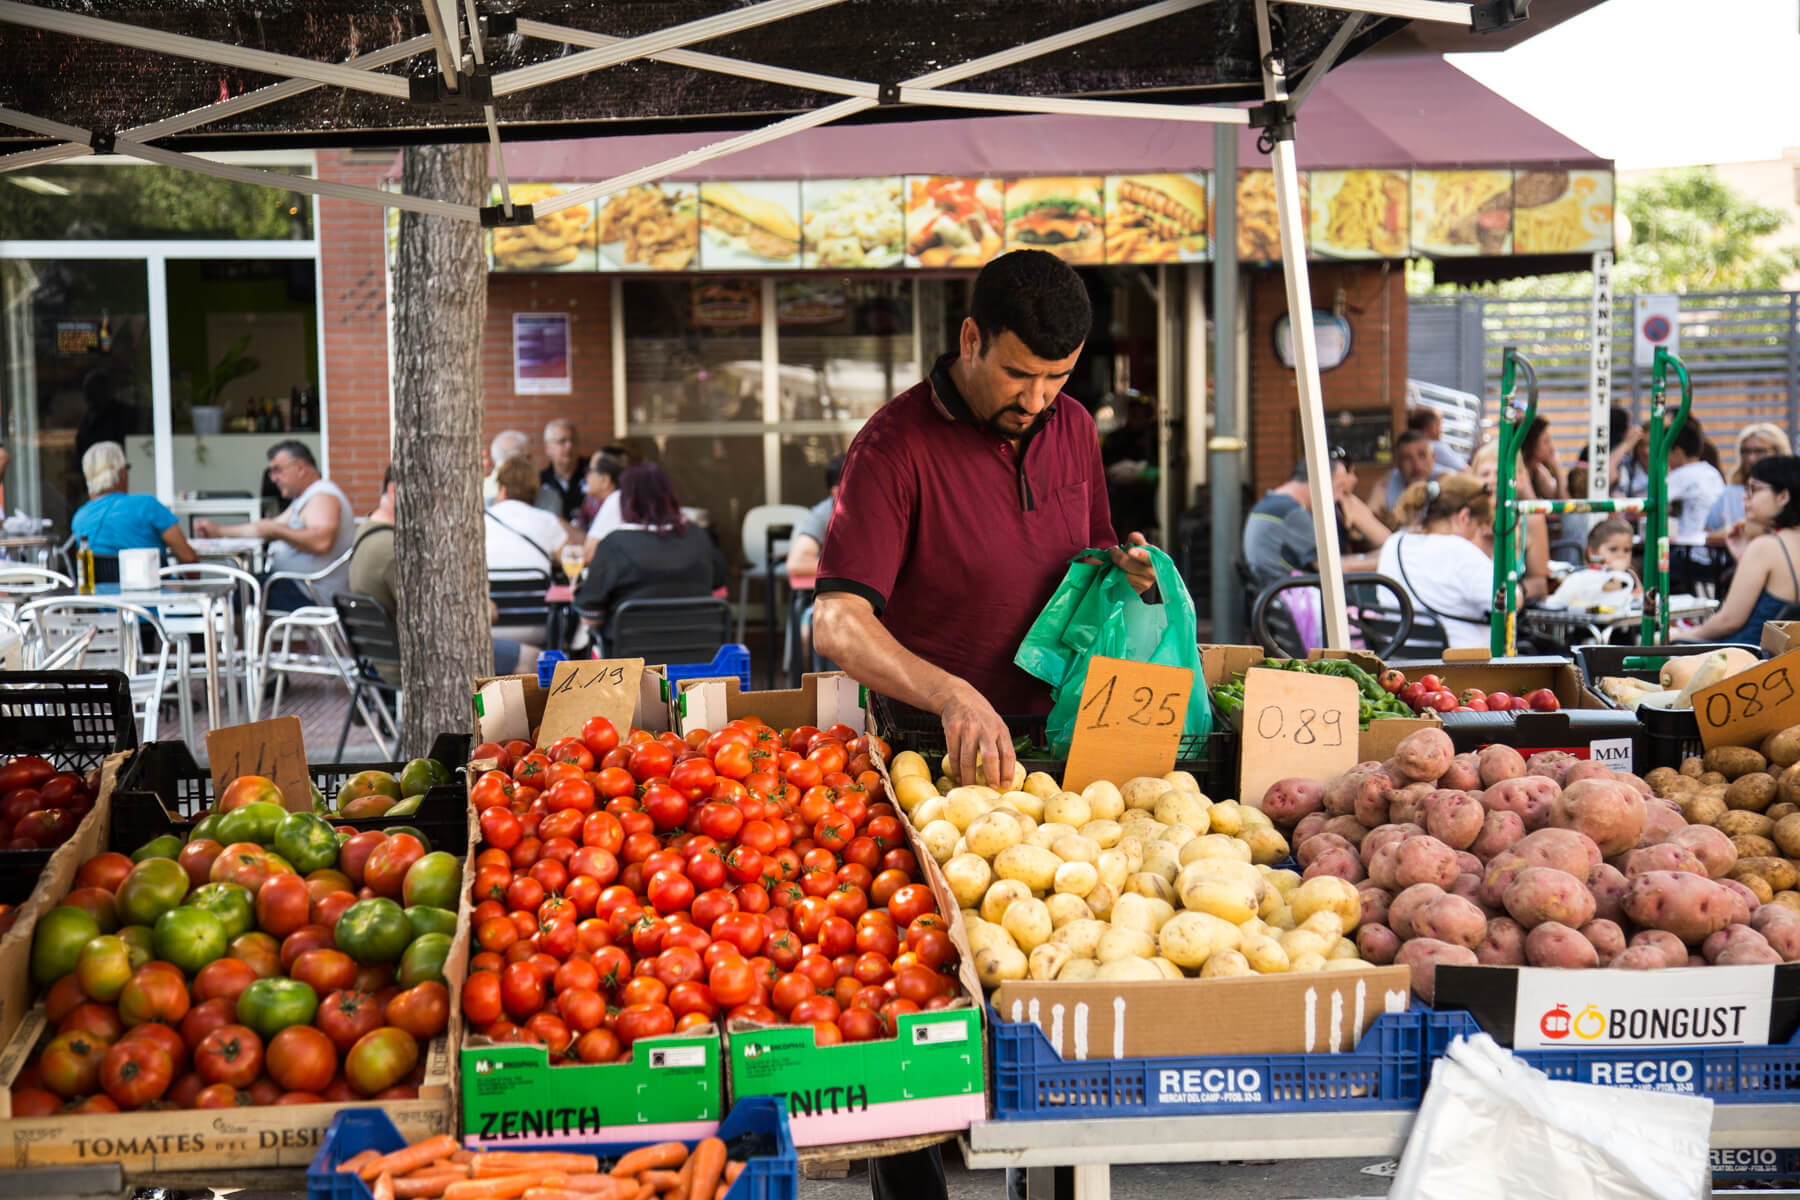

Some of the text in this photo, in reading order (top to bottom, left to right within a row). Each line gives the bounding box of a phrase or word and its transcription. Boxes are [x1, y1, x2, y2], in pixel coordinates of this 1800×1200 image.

[1597, 257, 1608, 404] FRANKFURT
[552, 667, 624, 696] 1.19
[1706, 668, 1794, 728] 0.89
[1083, 675, 1180, 730] 1.25
[1258, 705, 1342, 747] 0.89
[1595, 746, 1630, 761] MM
[1609, 1006, 1747, 1039] BONGUST
[1160, 1069, 1261, 1093] RECIO
[1592, 1060, 1693, 1085] RECIO
[773, 1085, 867, 1119] NITH
[479, 1106, 600, 1141] ZENITH
[73, 1132, 205, 1158] TOMATES
[259, 1128, 328, 1149] DESI
[1709, 1149, 1777, 1164] RECIO
